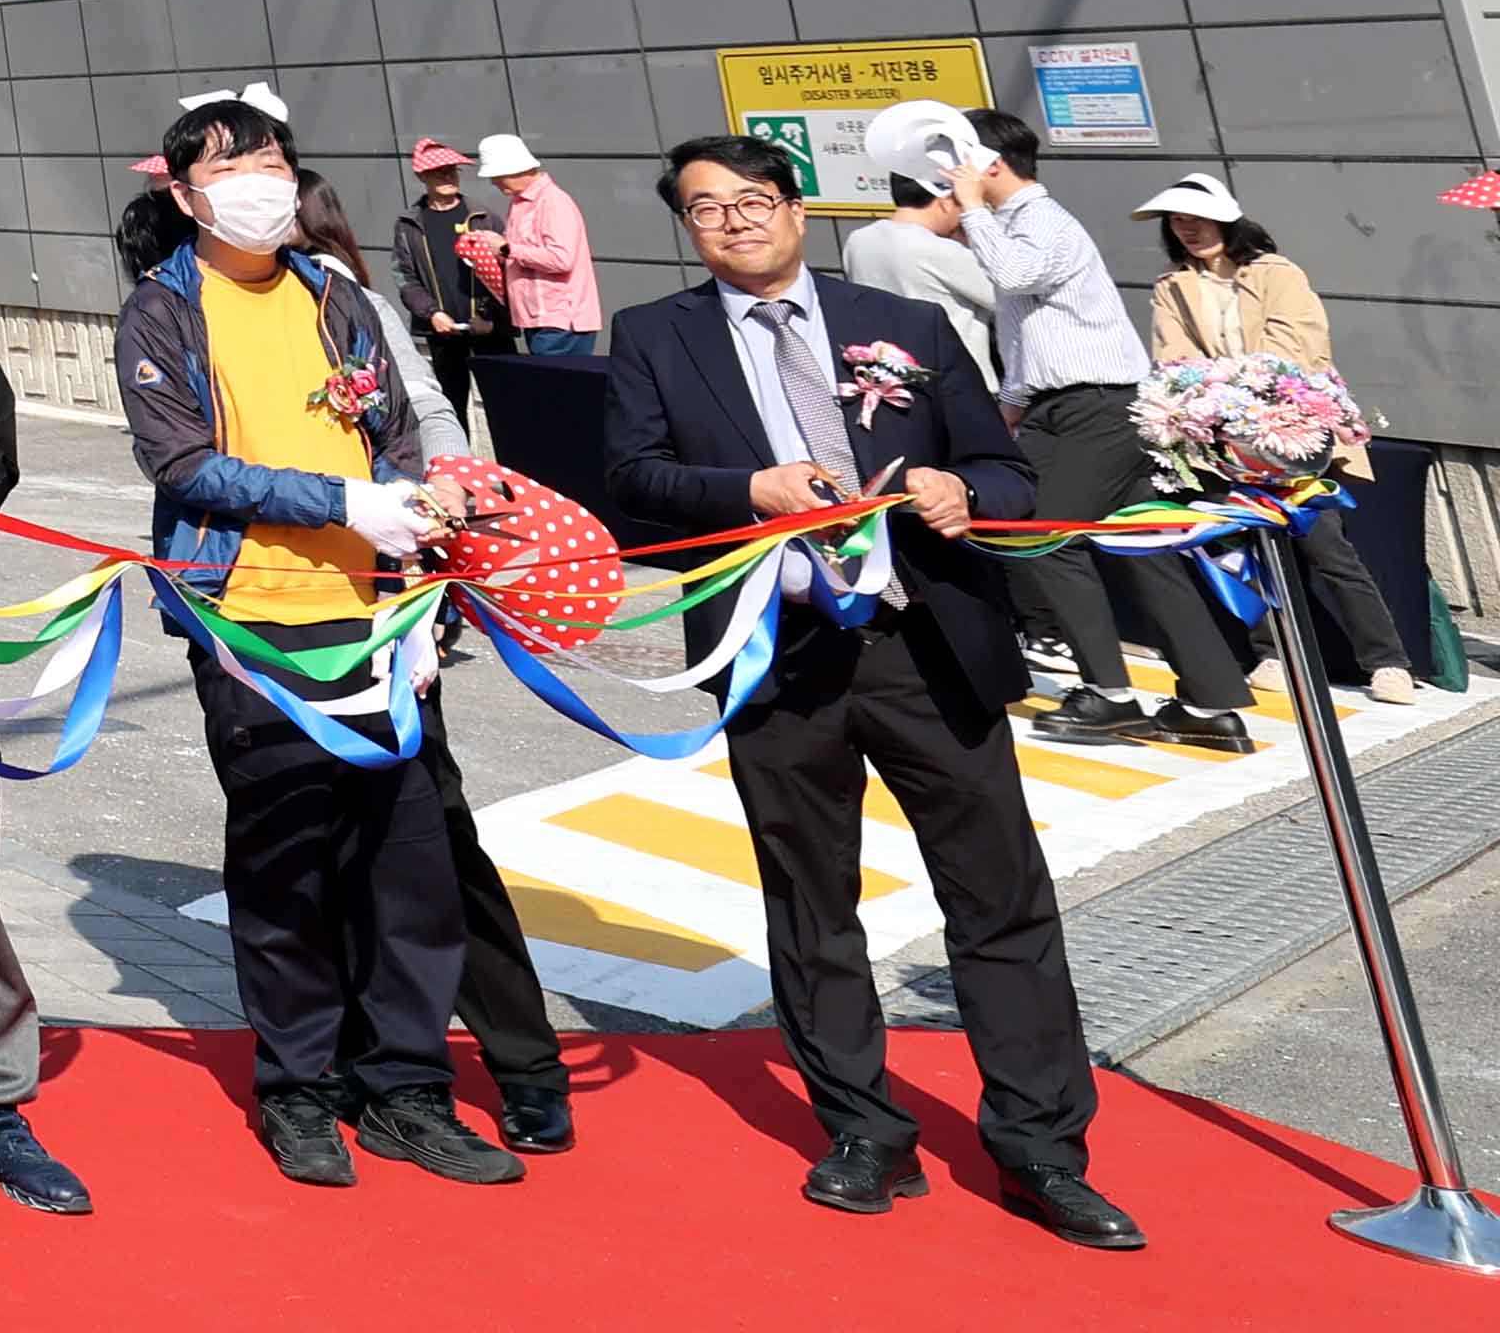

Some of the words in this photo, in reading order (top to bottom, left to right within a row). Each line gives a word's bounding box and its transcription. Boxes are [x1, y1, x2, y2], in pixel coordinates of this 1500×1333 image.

[1036, 50, 1073, 63] CCTV
[758, 63, 853, 86] 임시주거시설
[870, 60, 939, 83] 지진겸용
[802, 89, 851, 103] (DISASTER
[855, 88, 901, 102] SHELTER)
